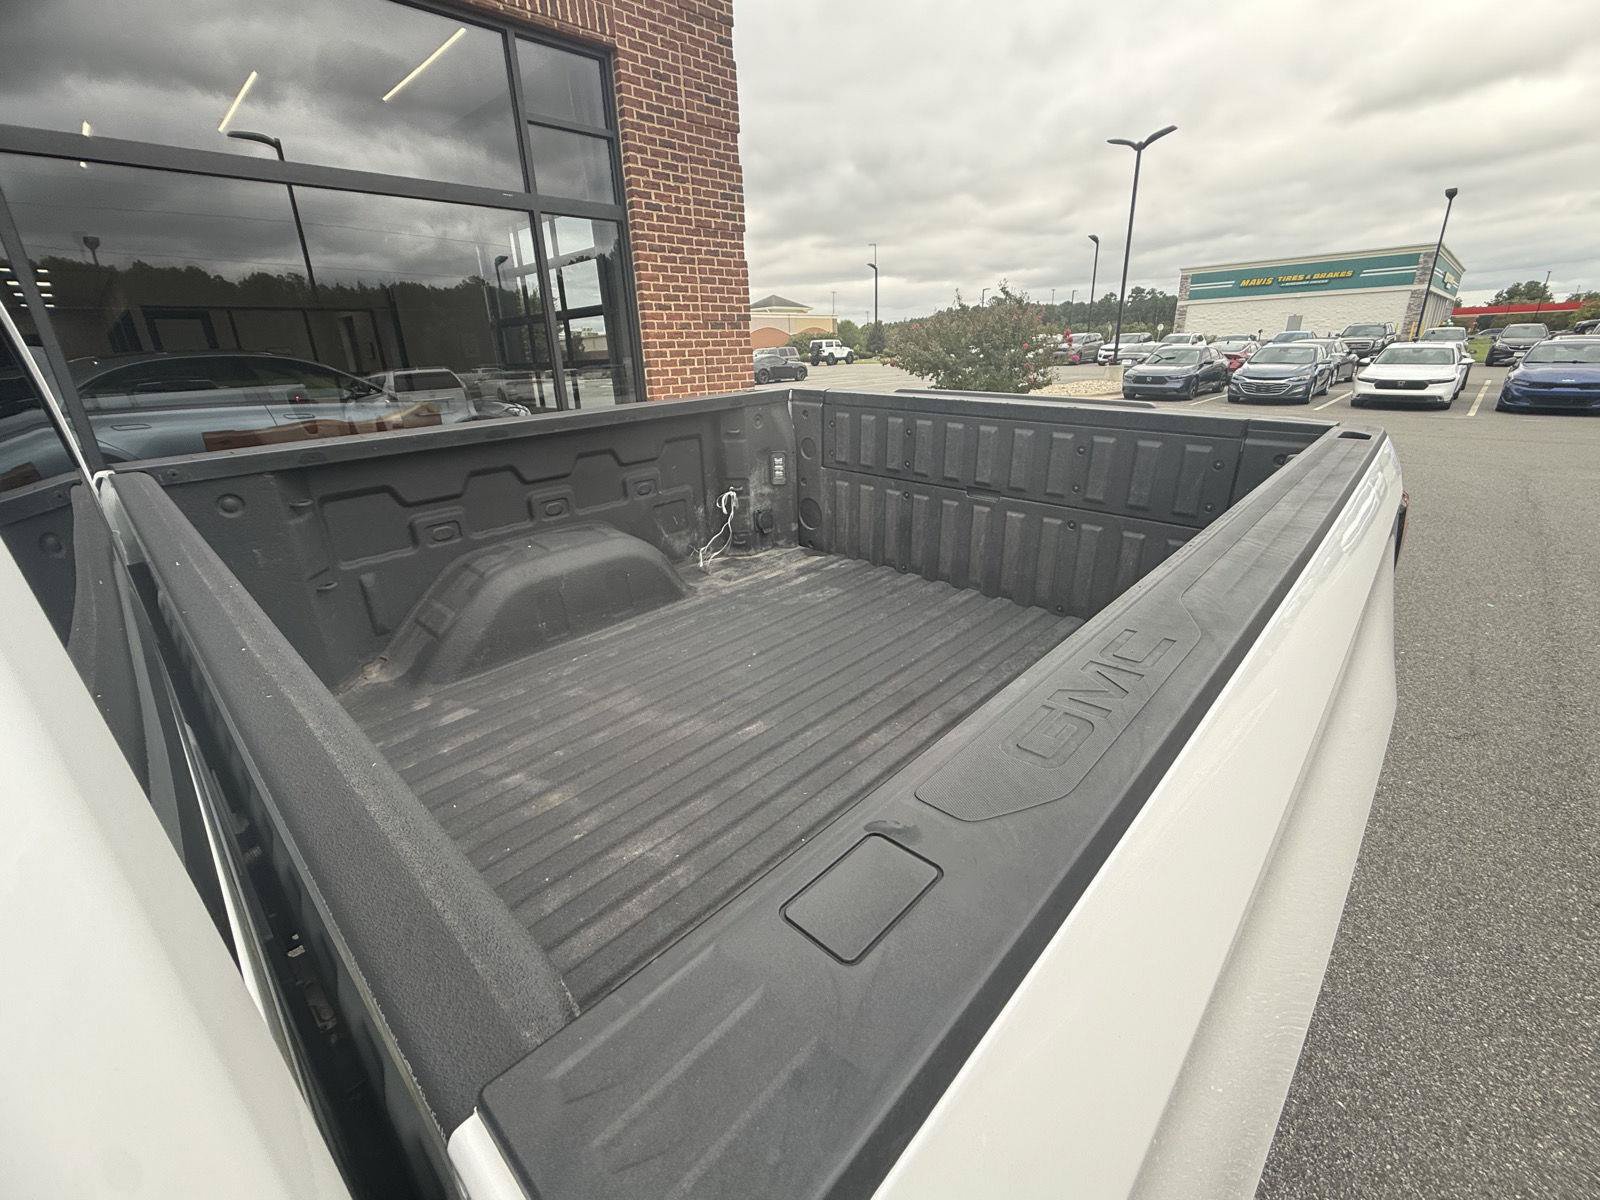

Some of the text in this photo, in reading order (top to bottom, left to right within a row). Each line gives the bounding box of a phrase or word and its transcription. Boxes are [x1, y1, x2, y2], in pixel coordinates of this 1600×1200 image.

[1240, 277, 1274, 287] MAVIS
[1277, 274, 1305, 282] TIRES
[1313, 270, 1354, 280] BRAKES
[1001, 628, 1176, 769] GMC
